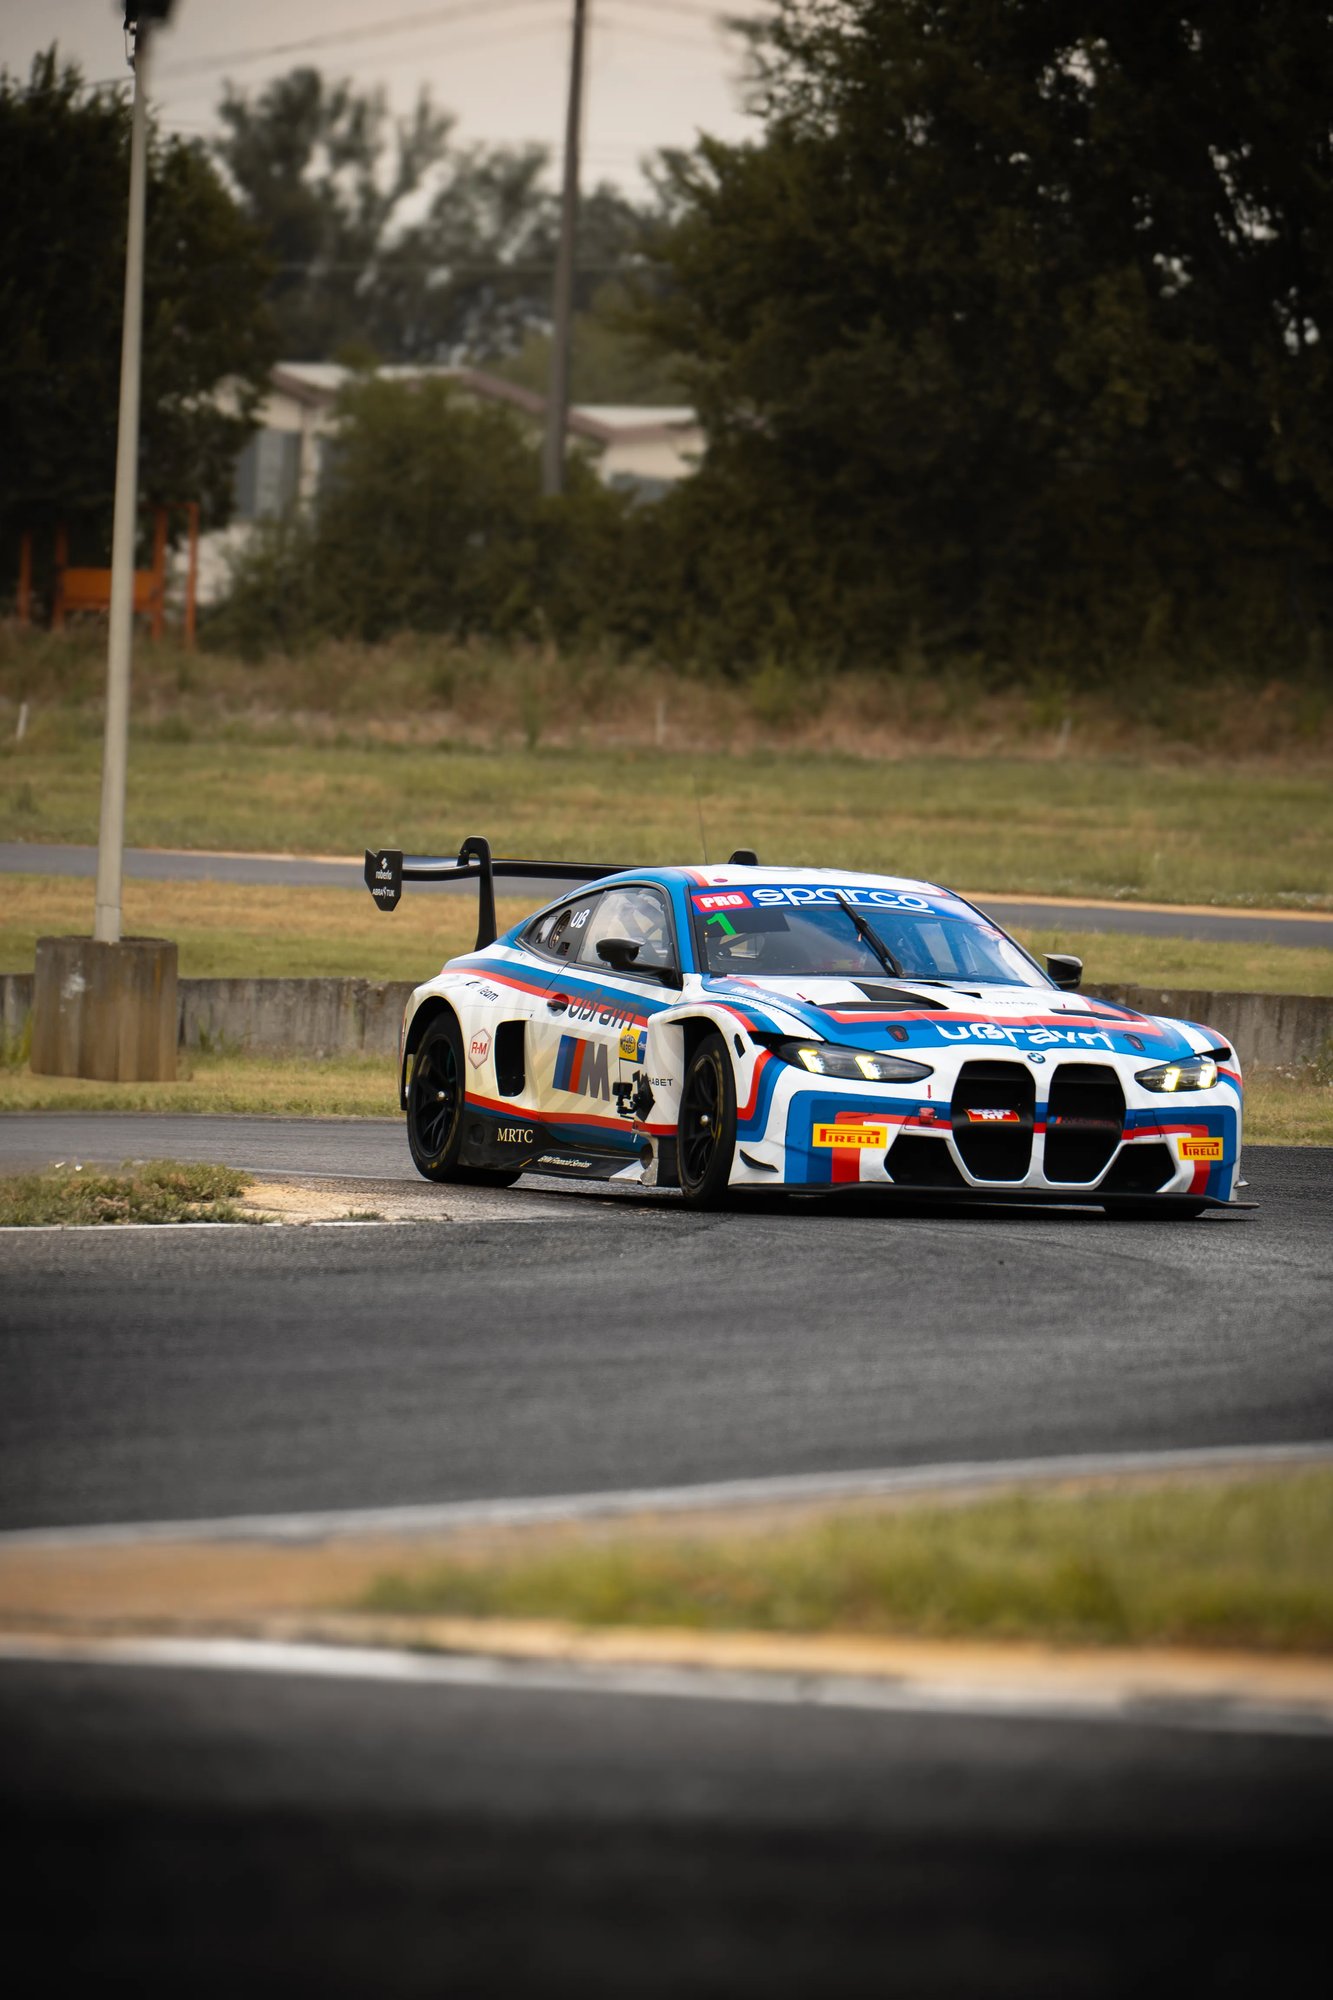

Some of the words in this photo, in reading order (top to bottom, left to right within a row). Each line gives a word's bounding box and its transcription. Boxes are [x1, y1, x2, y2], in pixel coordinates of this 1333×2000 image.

[701, 894, 744, 908] PRO
[752, 887, 930, 909] sparco
[571, 909, 590, 928] UB
[707, 912, 737, 936] 1
[577, 1040, 610, 1102] M
[497, 1127, 534, 1143] MRTC
[820, 1129, 880, 1144] PIRELLI
[1182, 1142, 1219, 1156] PIRELLI
